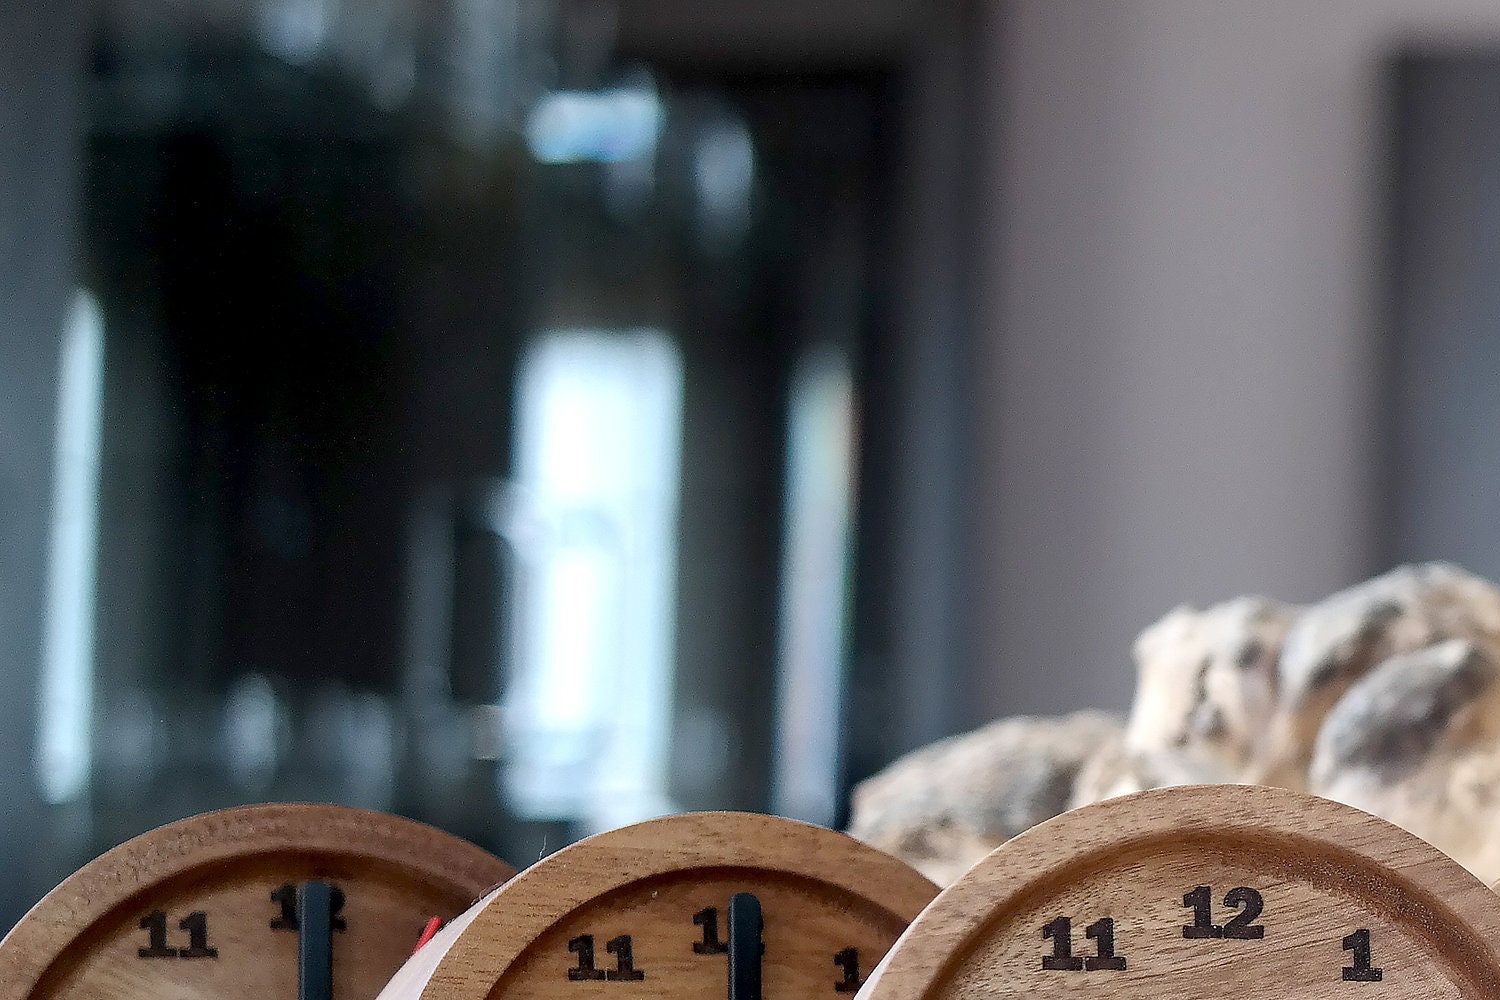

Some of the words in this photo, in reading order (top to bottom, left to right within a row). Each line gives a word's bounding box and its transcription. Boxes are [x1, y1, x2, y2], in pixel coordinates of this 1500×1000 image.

[138, 911, 218, 959] 11
[693, 906, 766, 954] 1
[1182, 886, 1264, 940] 12
[568, 934, 644, 981] 11
[1041, 916, 1127, 971] 11
[1342, 929, 1382, 982] 1
[834, 947, 863, 993] 1
